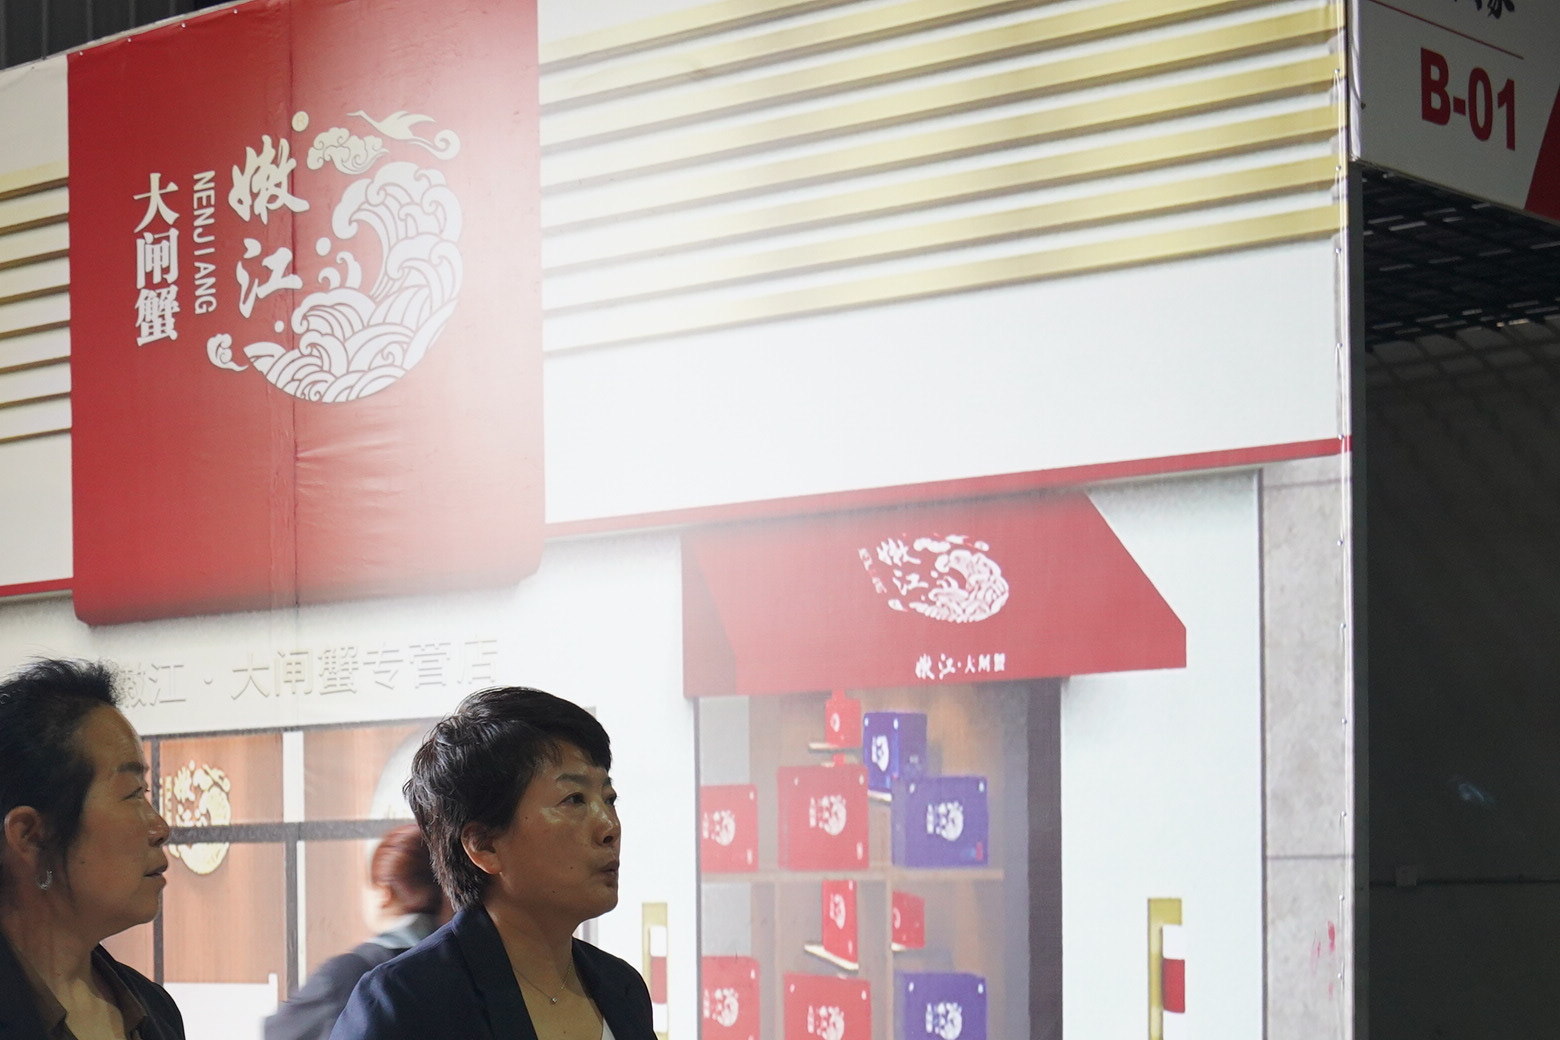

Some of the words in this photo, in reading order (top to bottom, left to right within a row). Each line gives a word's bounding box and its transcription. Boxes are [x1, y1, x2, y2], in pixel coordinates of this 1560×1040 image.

[1420, 47, 1516, 152] B-01
[133, 172, 181, 348] 大闸蟹
[192, 169, 218, 316] NENJIANG
[227, 134, 310, 319] 嫩江
